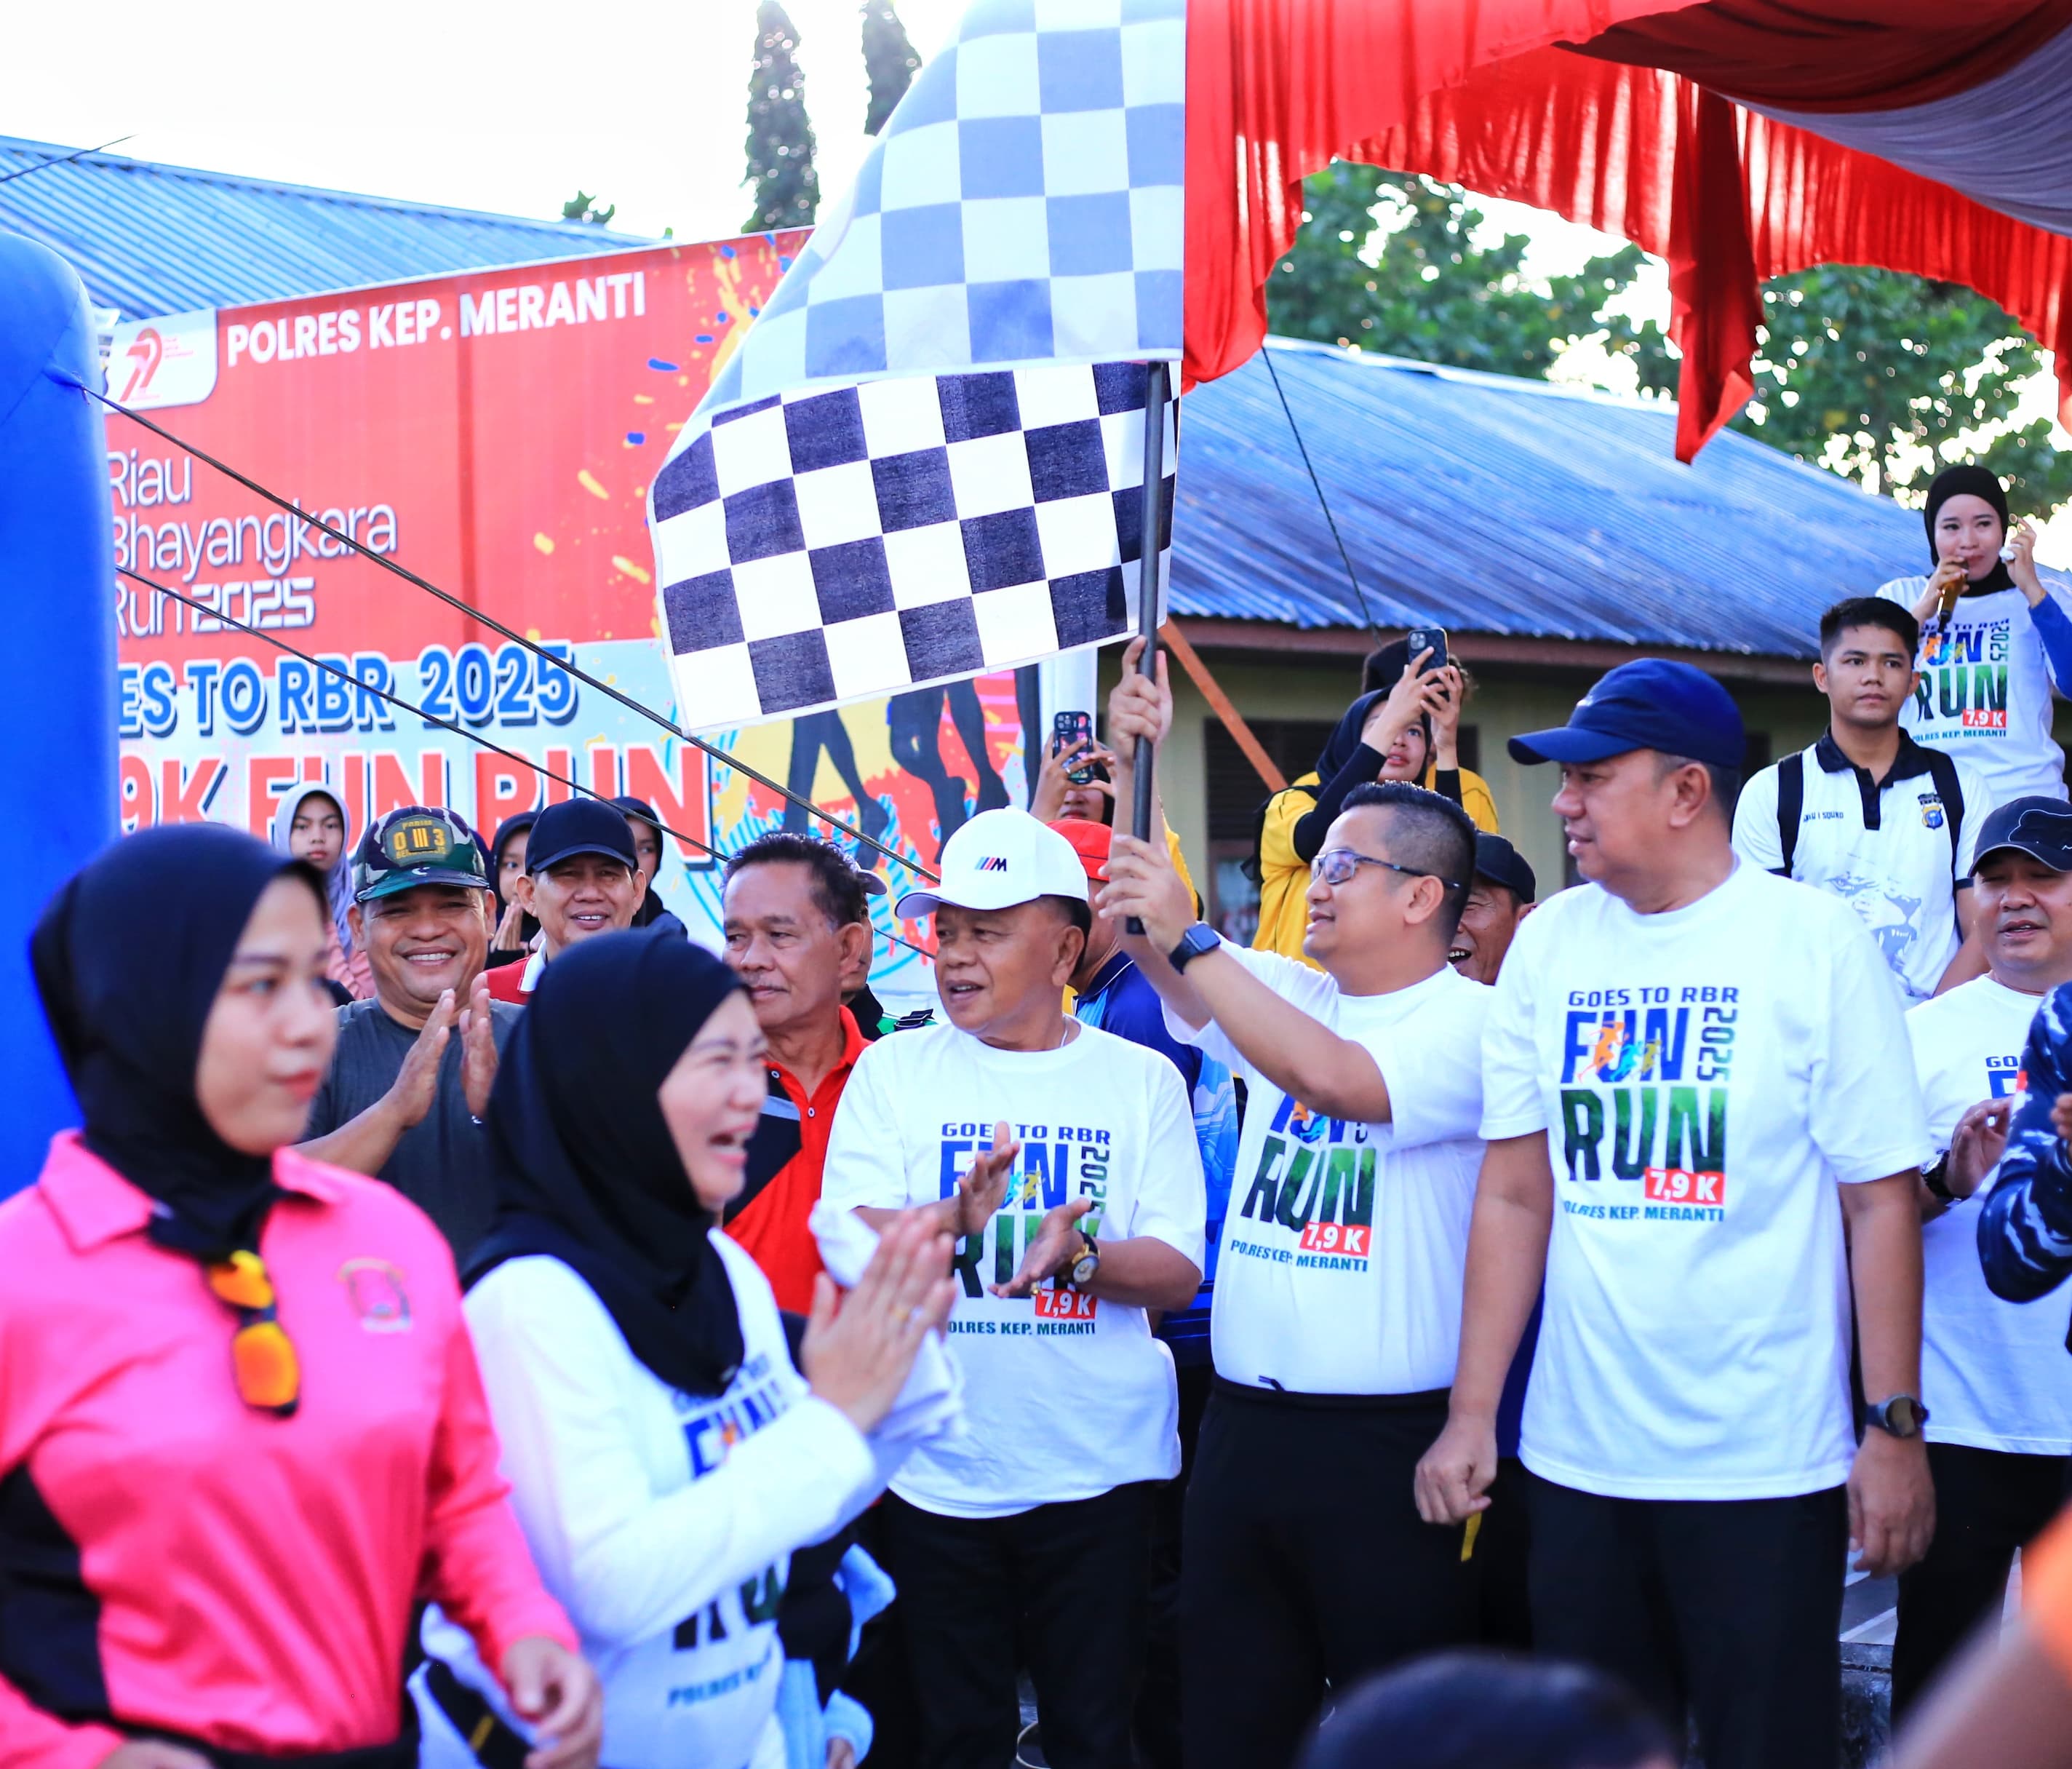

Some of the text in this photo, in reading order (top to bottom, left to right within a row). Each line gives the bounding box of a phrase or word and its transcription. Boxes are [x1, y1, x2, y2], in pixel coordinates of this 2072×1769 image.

[226, 271, 646, 367] POLRES KEP. MERANTI
[107, 447, 192, 507] Riau
[113, 498, 398, 583] Bhayangkara
[116, 576, 315, 637] Run 2025
[118, 641, 581, 736] ES TO RBR 2025
[1914, 665, 2008, 723] RUN
[1963, 729, 2007, 738] MERANTI
[119, 752, 227, 837] 9K
[433, 828, 446, 846] 3
[1568, 986, 1739, 1007] GOES TO RBR
[1560, 1007, 1690, 1084] FUN
[1696, 1006, 1739, 1082] 2025
[1985, 1055, 2019, 1068] GO
[941, 1122, 1111, 1145] GOE TO RBR
[1560, 1086, 1727, 1181] RUN
[1239, 1134, 1376, 1233] RUN
[1649, 1170, 1718, 1202] 7,9 K
[1609, 1206, 1640, 1220] KEP.
[1644, 1206, 1725, 1223] MERANTI
[1306, 1224, 1365, 1253] 7,9 K
[1296, 1255, 1369, 1273] MERANTI
[1040, 1290, 1093, 1318] 7,9 K
[948, 1321, 1096, 1336] OLRES KEP. MERANTI
